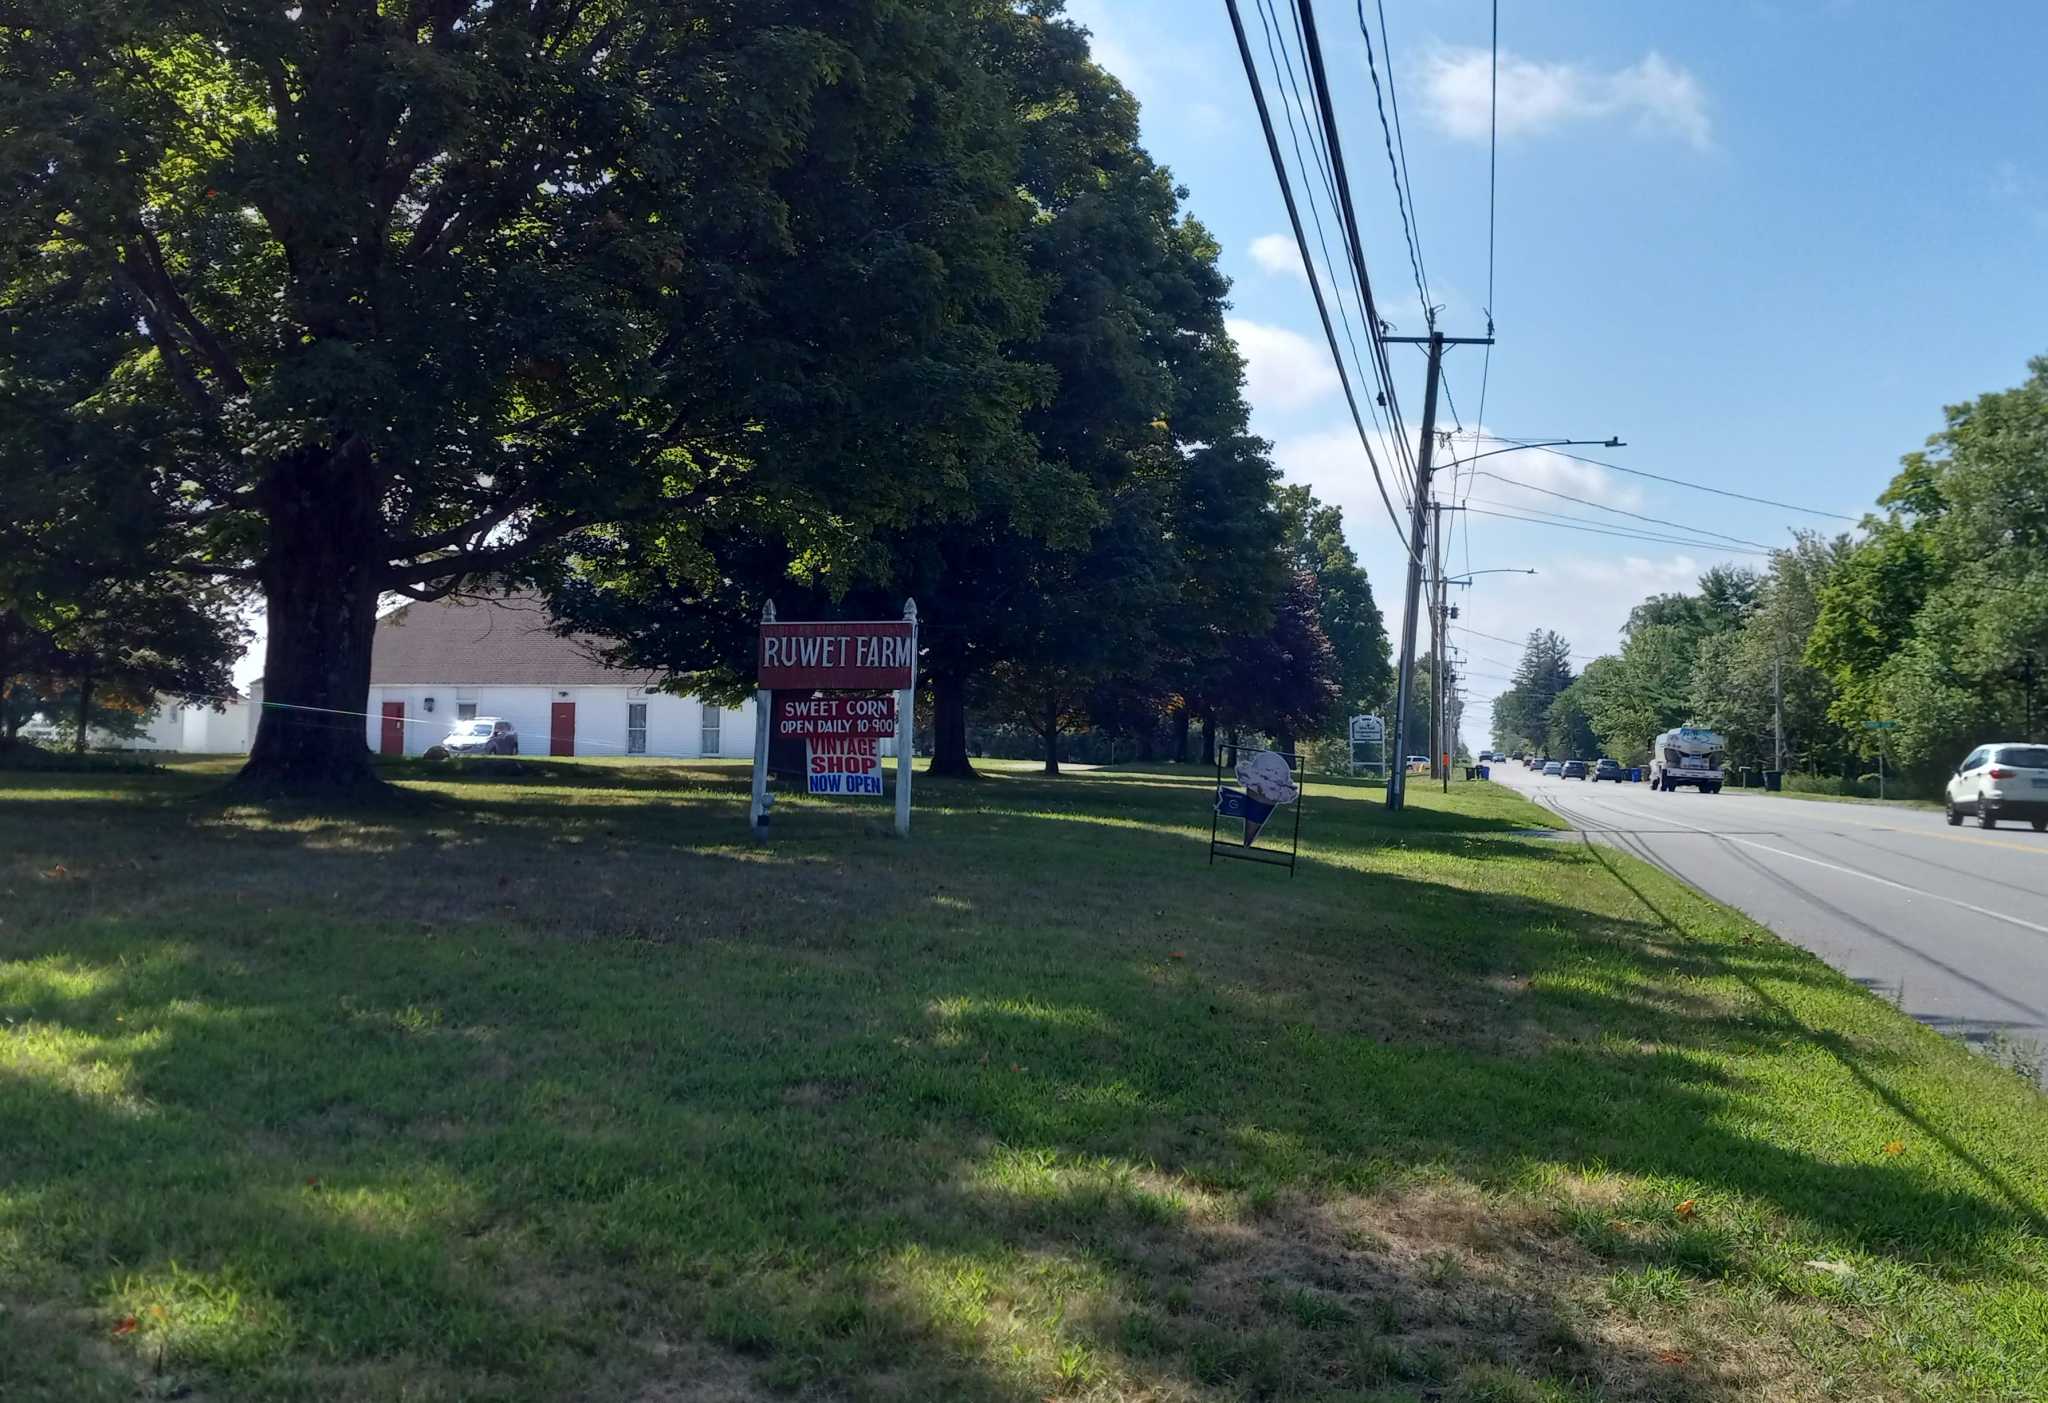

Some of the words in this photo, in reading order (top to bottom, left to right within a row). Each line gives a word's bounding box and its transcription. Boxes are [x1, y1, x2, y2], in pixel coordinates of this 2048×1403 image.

[763, 636, 851, 667] RUWET
[855, 636, 911, 667] FARM
[785, 701, 839, 717] SWEET
[846, 700, 887, 718] CORN
[780, 719, 813, 734] OPEN
[817, 719, 852, 733] DAILY
[810, 737, 877, 757] VINTAGE
[811, 756, 877, 774] SHOP
[809, 775, 842, 793] NOW
[846, 775, 881, 793] OPEN
